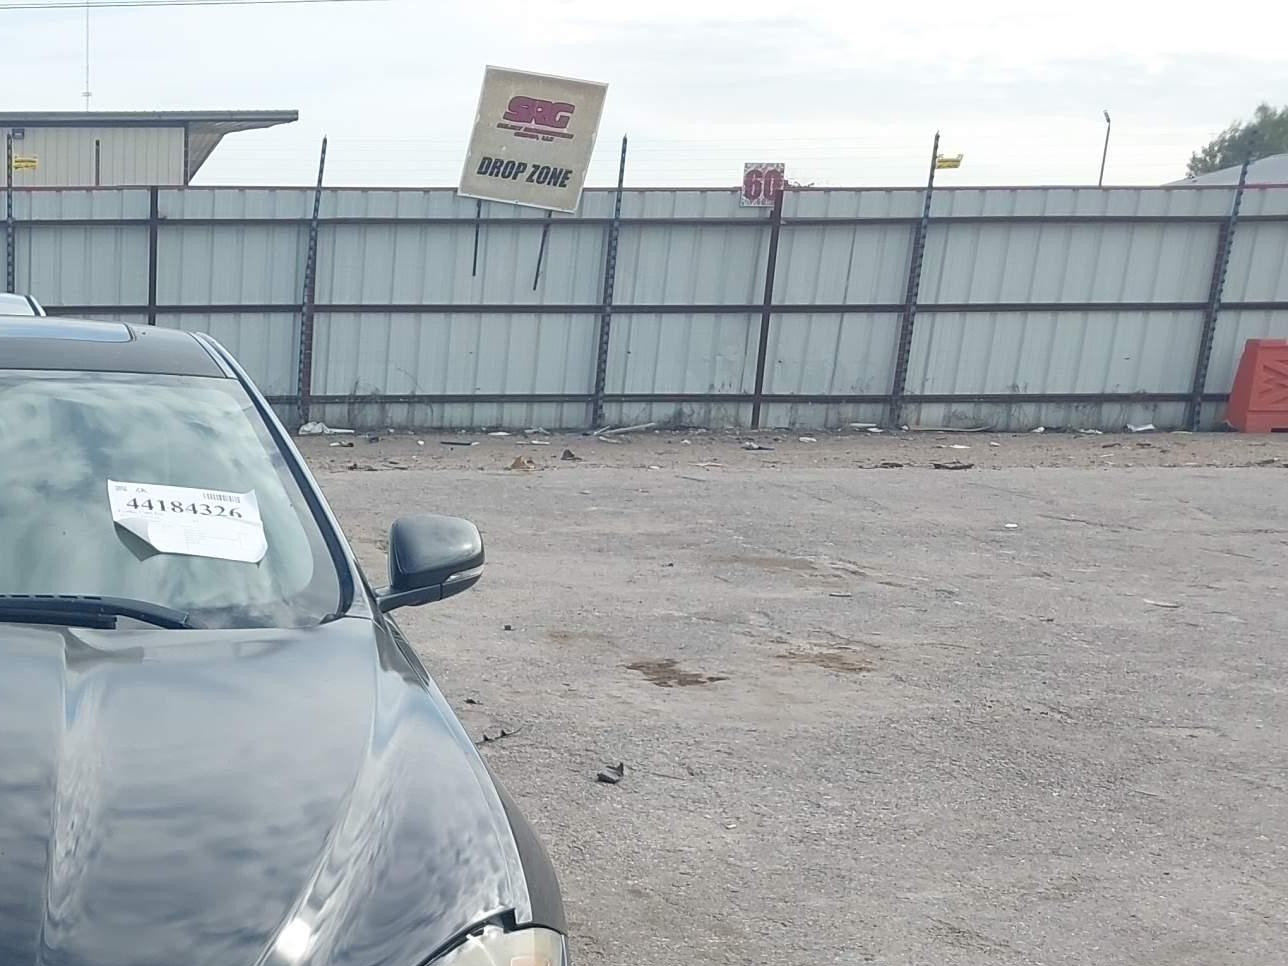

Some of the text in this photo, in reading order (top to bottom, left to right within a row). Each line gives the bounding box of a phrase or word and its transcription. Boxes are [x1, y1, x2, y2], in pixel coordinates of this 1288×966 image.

[503, 95, 575, 129] SRG
[477, 156, 573, 188] DROP ZONE
[743, 169, 783, 202] 60
[126, 497, 243, 519] 44184326
